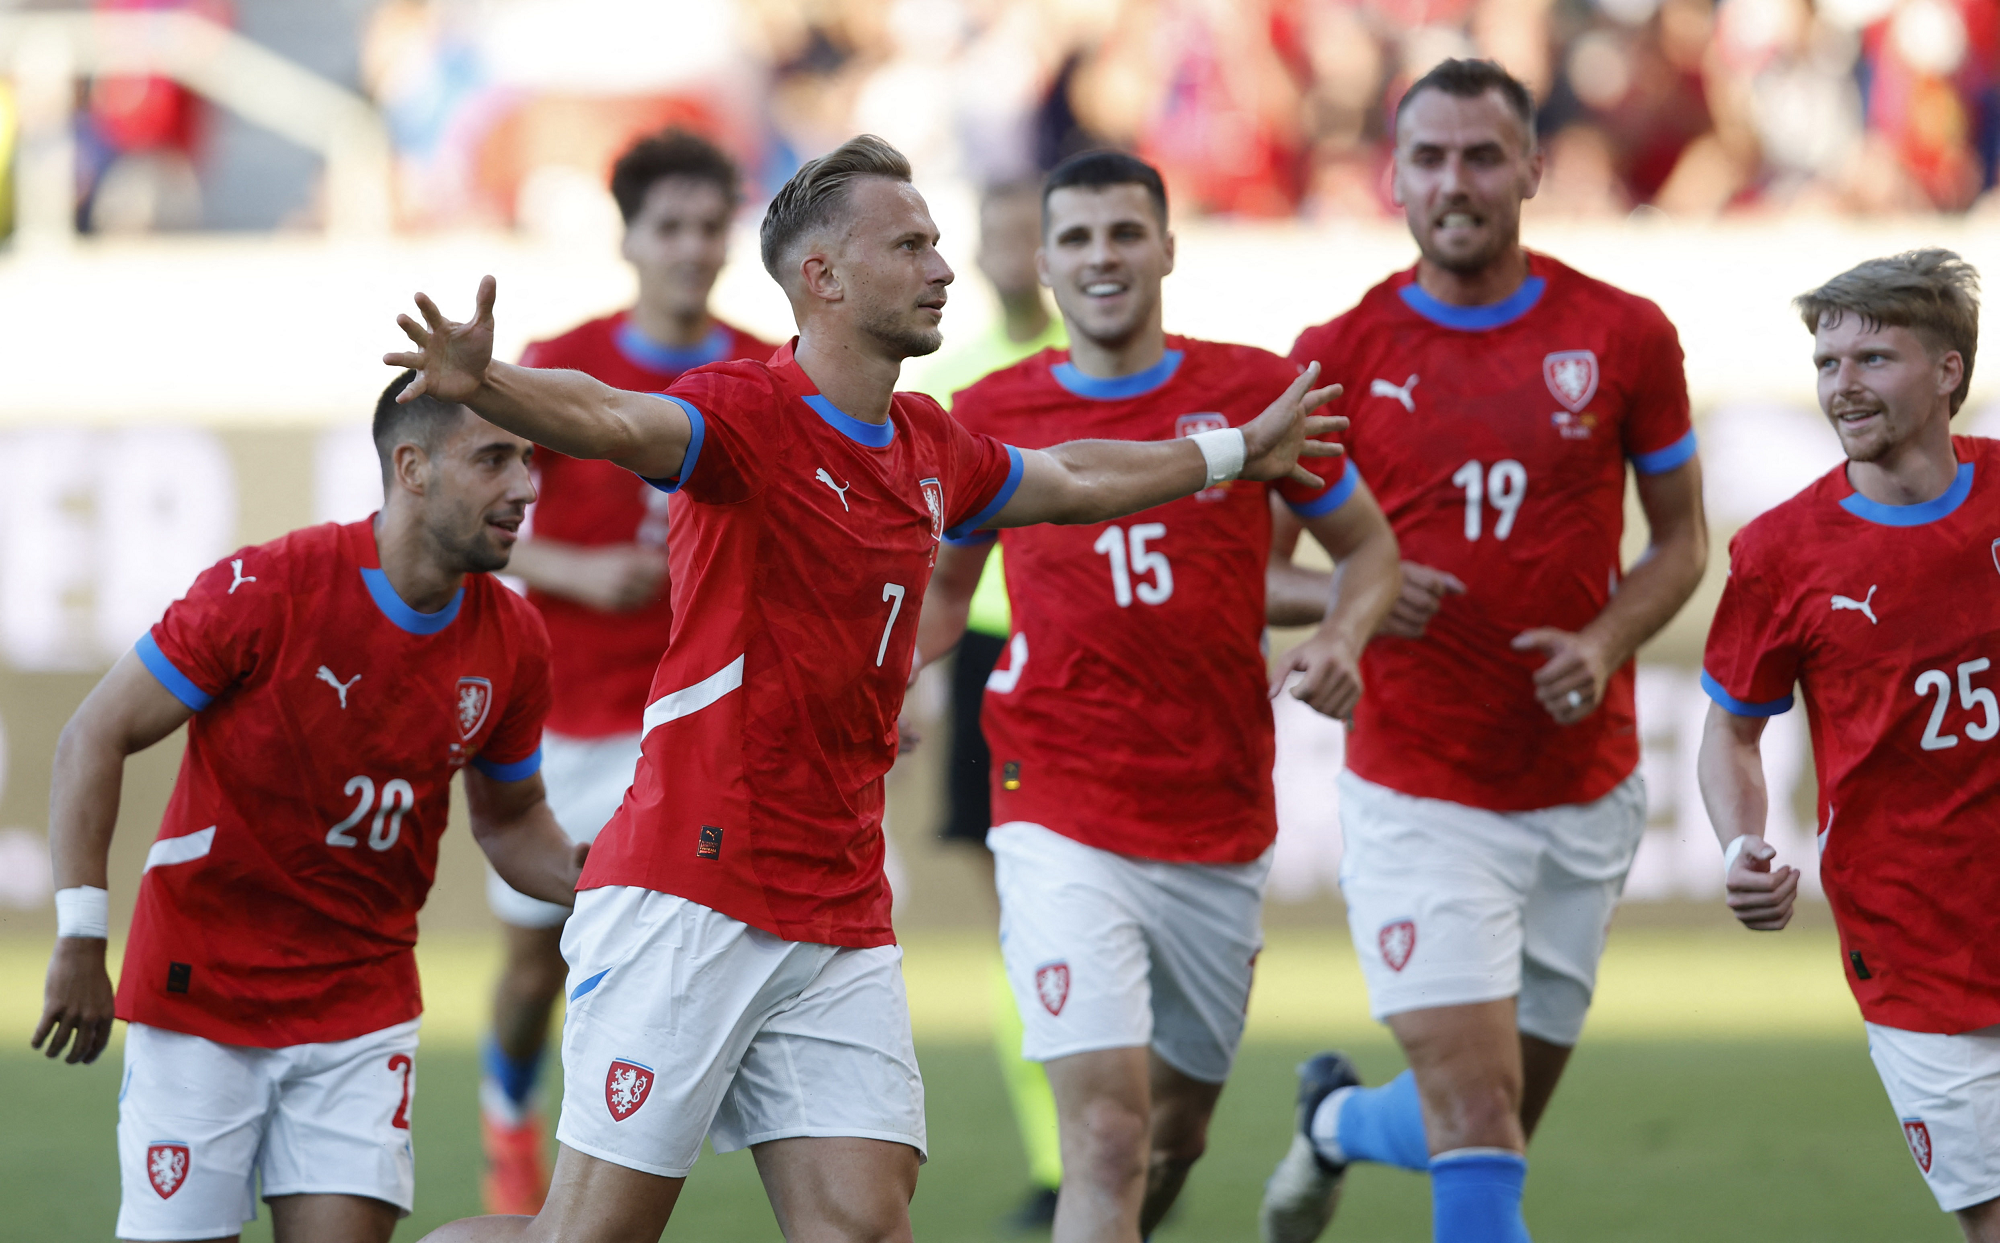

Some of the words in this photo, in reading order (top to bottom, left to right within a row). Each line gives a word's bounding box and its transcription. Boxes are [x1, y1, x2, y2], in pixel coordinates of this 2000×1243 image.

[1453, 460, 1527, 540] 19
[1094, 523, 1173, 606] 15
[877, 583, 905, 667] 7
[1915, 657, 2000, 750] 25
[326, 776, 415, 850] 20
